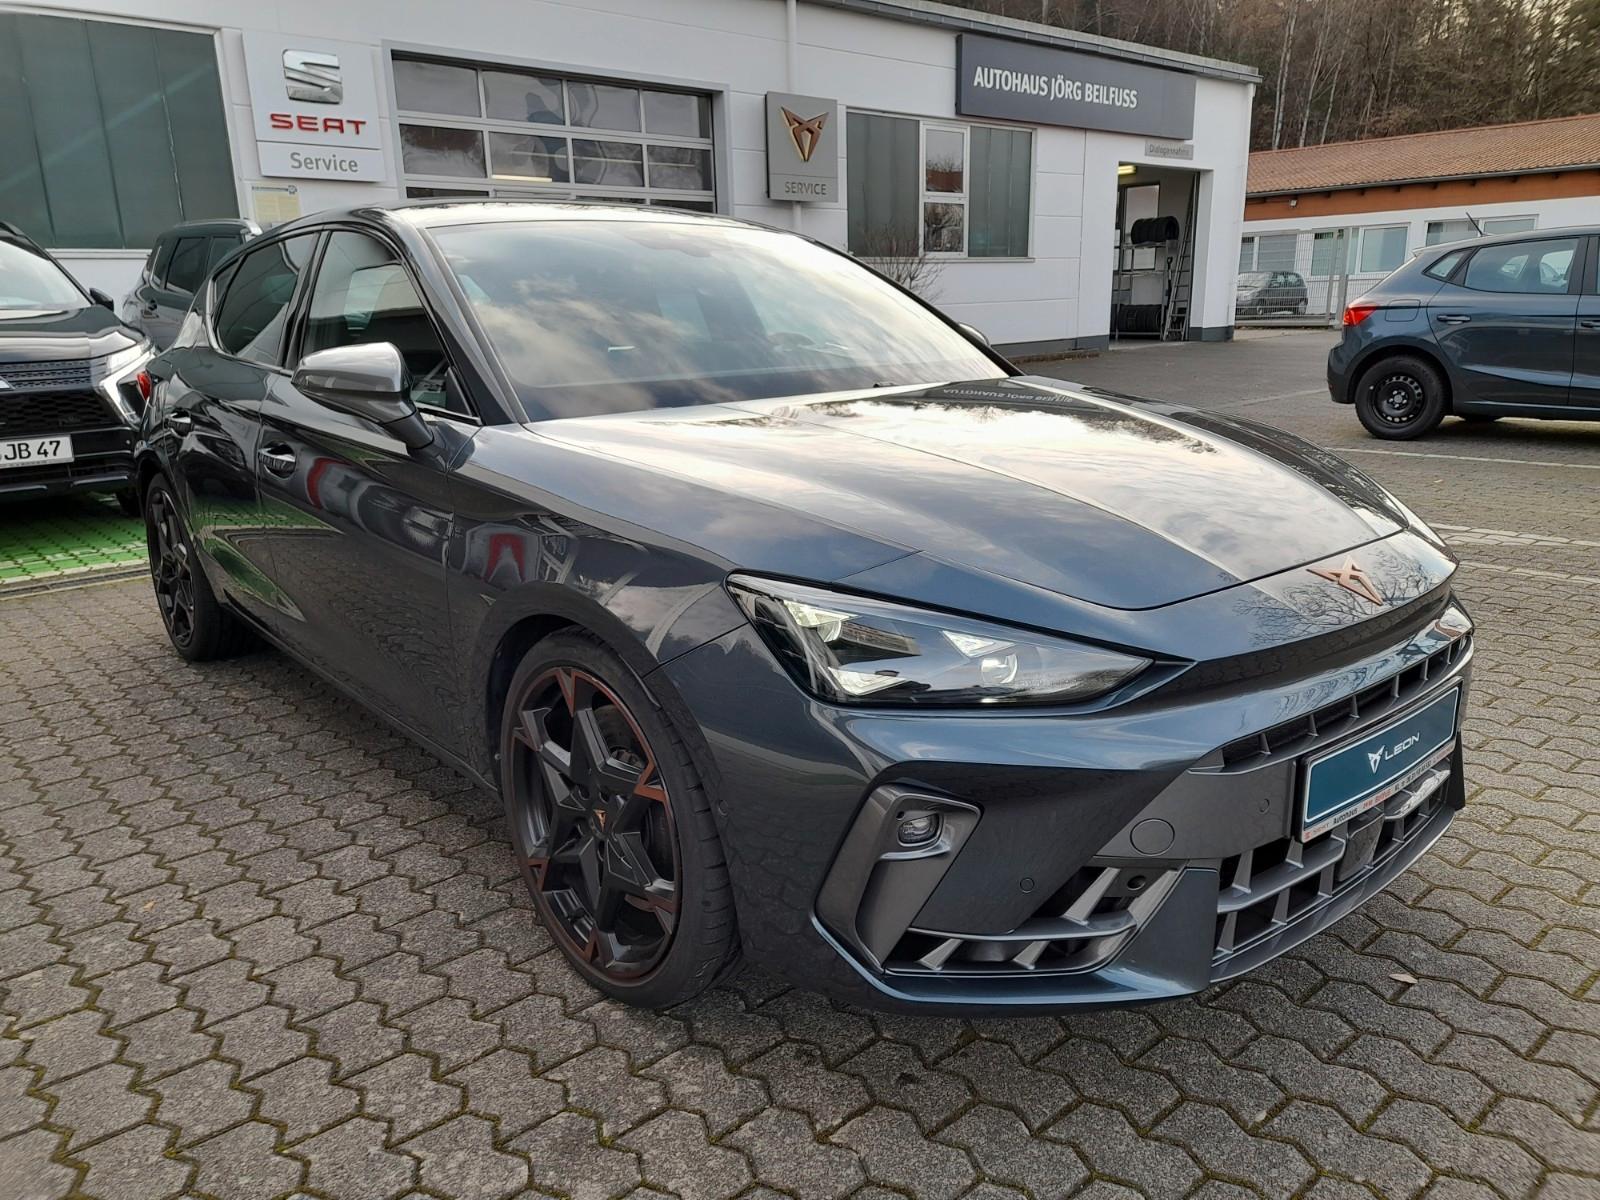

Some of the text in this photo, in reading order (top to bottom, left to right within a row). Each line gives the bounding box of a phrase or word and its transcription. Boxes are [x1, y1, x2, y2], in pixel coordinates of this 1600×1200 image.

[973, 66, 1138, 109] AUTOHAUS JÖRG BEILFUSS
[270, 113, 367, 135] SEAT
[290, 151, 359, 173] Service
[785, 181, 827, 196] SERVICE
[4, 440, 61, 460] JB 47
[1384, 731, 1420, 761] LEON
